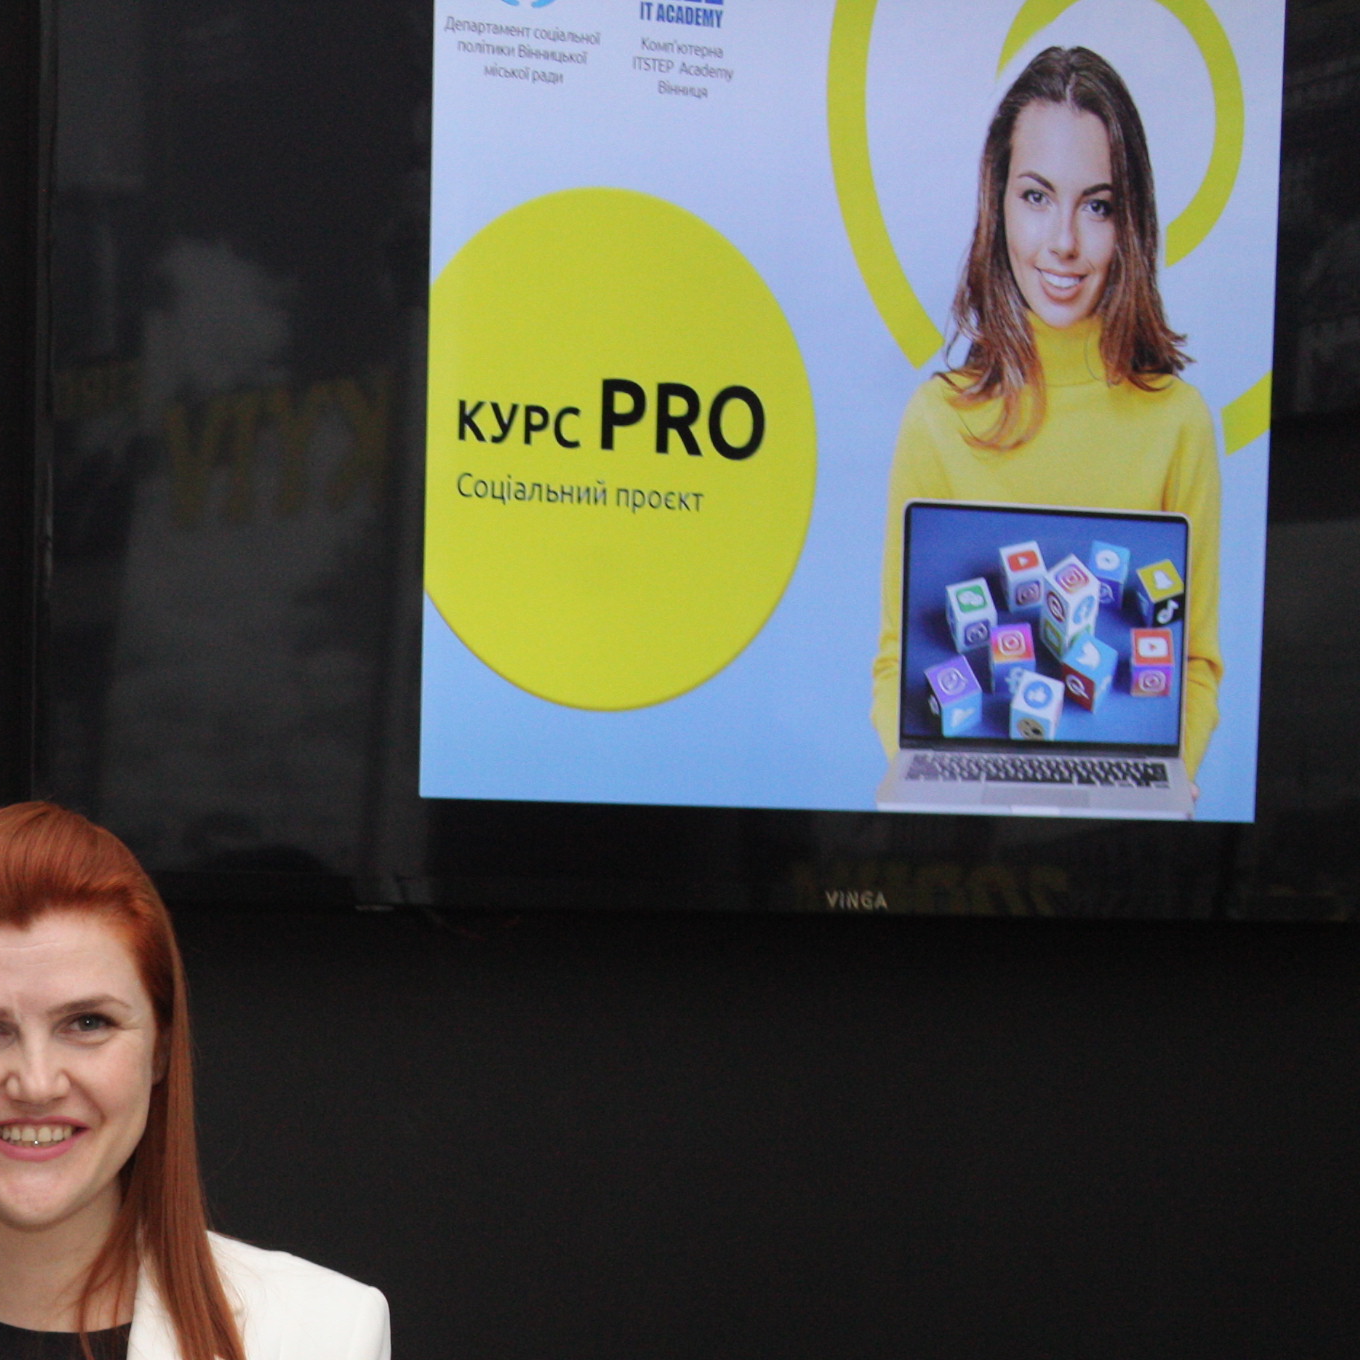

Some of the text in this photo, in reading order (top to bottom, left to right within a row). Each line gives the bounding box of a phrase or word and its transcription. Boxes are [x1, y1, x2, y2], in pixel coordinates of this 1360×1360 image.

[640, 2, 723, 28] IT ACADEMY
[444, 16, 601, 46] Департамент соціальної
[457, 39, 588, 64] політики Вінницької
[484, 62, 564, 84] міської ради
[633, 56, 734, 82] ITSTEP Academy
[658, 80, 708, 98] Вінниця
[458, 378, 766, 461] КУРС PRO
[457, 472, 704, 513] Соціальний проєкт
[825, 890, 888, 910] VINGA
